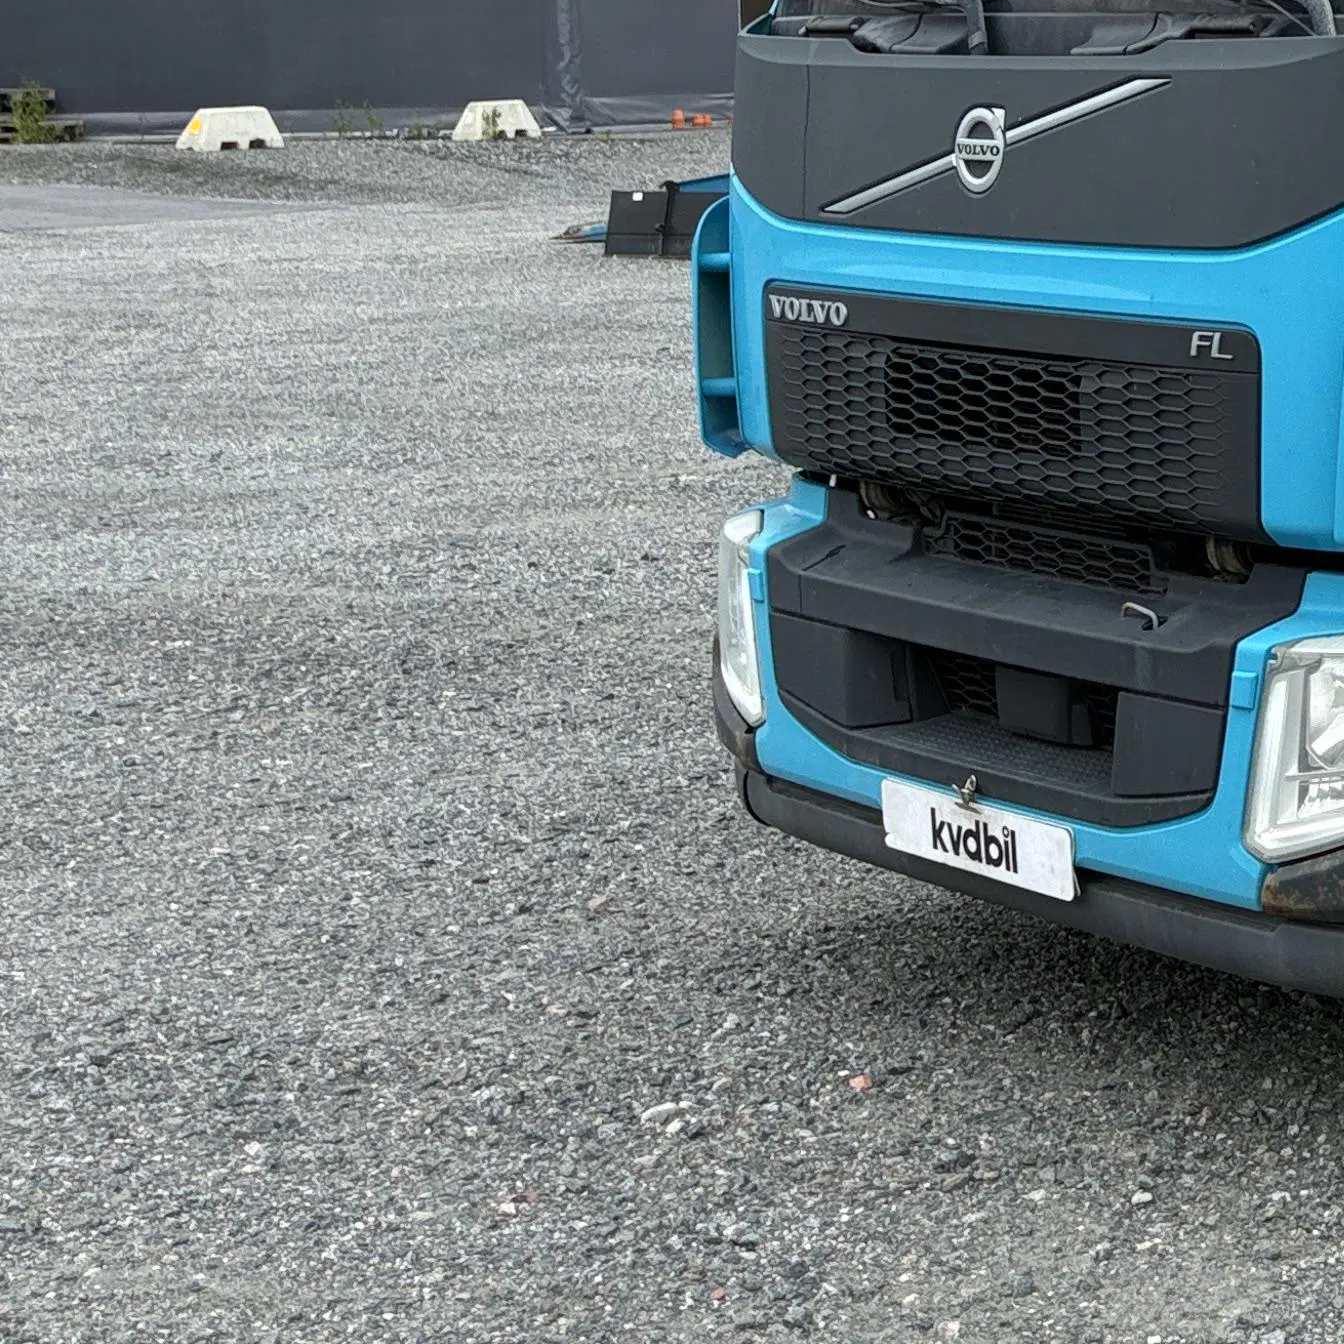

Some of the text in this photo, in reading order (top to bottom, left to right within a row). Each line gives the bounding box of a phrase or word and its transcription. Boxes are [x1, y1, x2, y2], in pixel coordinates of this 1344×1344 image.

[957, 143, 1000, 157] VOLVO
[768, 293, 848, 326] VOLVO
[1190, 331, 1233, 360] FL
[930, 807, 1018, 874] kvdbil
